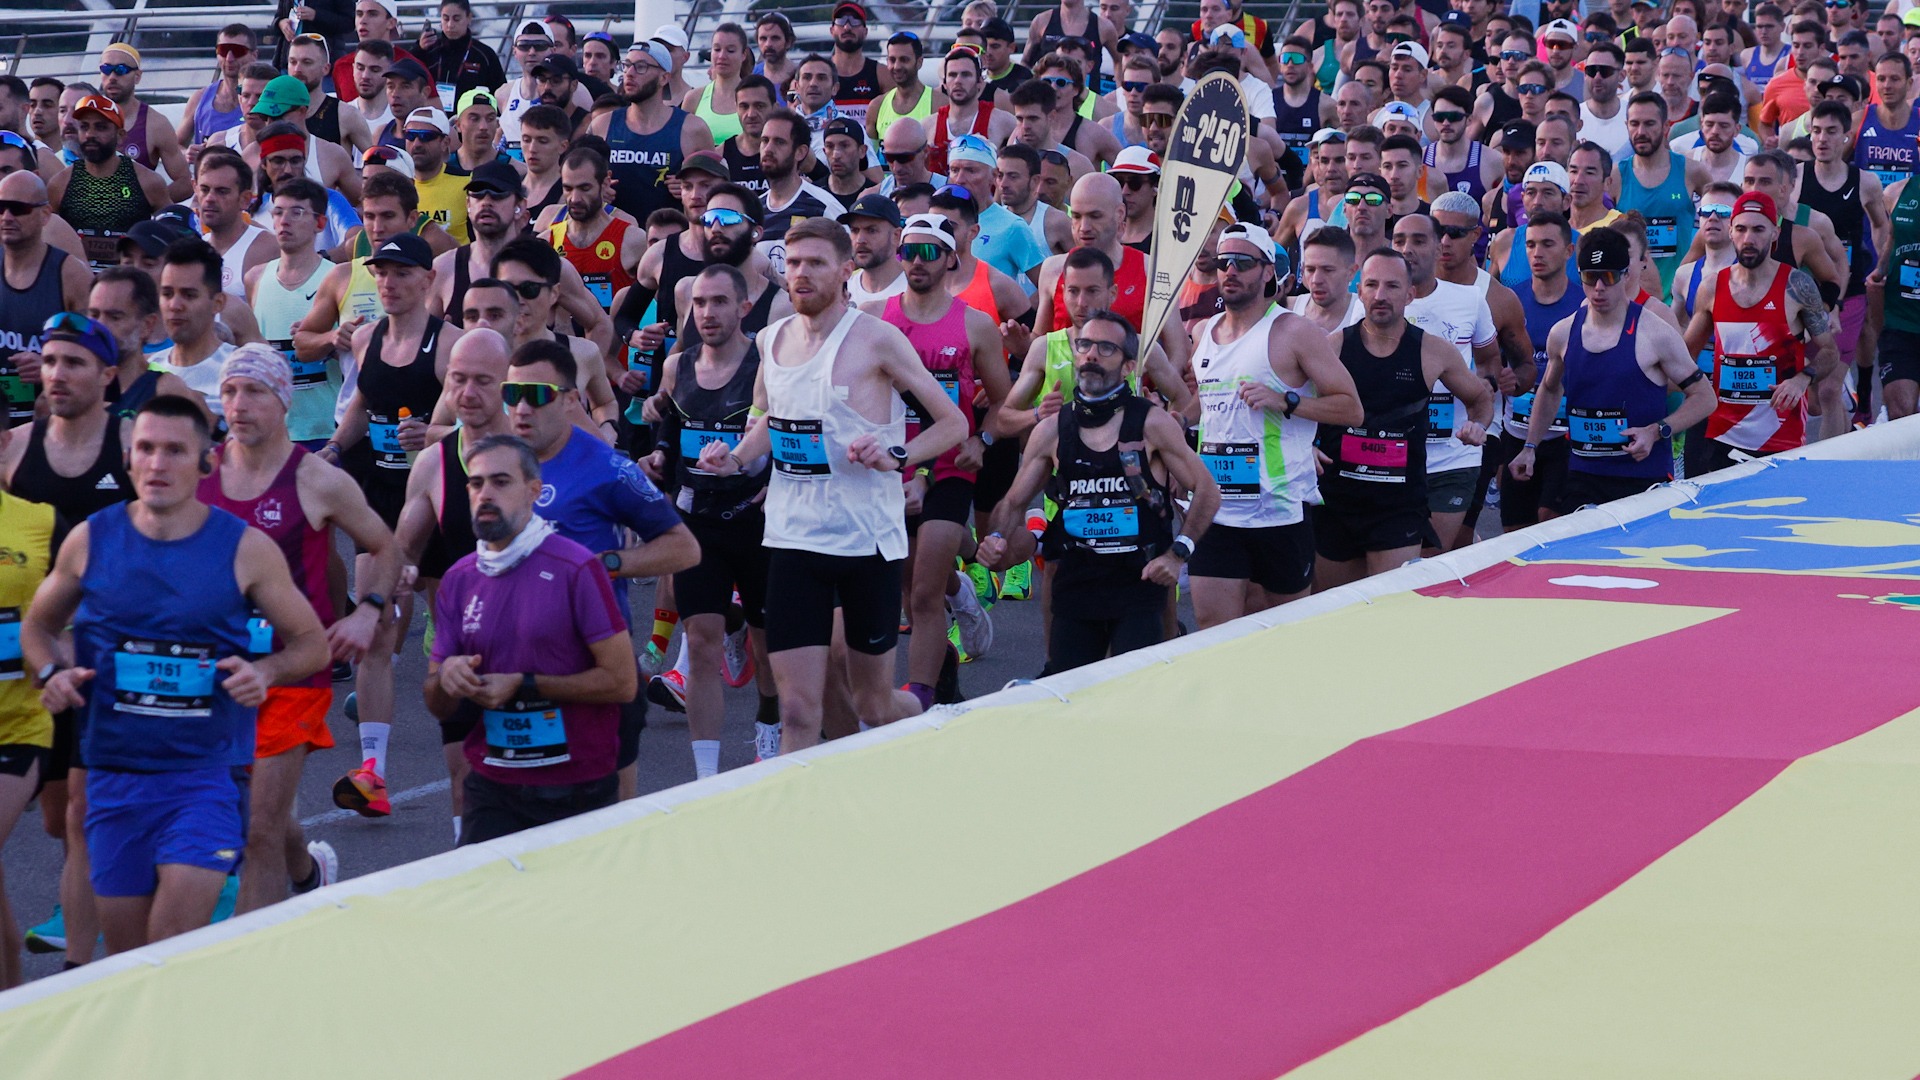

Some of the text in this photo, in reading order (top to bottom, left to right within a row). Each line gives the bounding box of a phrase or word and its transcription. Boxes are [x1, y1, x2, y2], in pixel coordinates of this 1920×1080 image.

[609, 149, 667, 166] REDOLAT
[1868, 145, 1913, 163] FRANCE
[1732, 370, 1756, 380] 1928
[1731, 382, 1758, 391] AREIAS
[1604, 410, 1621, 418] ZURICH
[1584, 421, 1607, 432] 6136
[781, 436, 802, 449] 2761
[1588, 432, 1603, 442] Seb
[1360, 441, 1387, 454] 6405
[780, 450, 808, 462] MARIUS
[1213, 460, 1236, 471] 1131
[1085, 512, 1114, 524] 2842
[1082, 526, 1120, 537] Eduardo
[146, 661, 182, 677] 3161
[506, 734, 532, 746] FEDE
